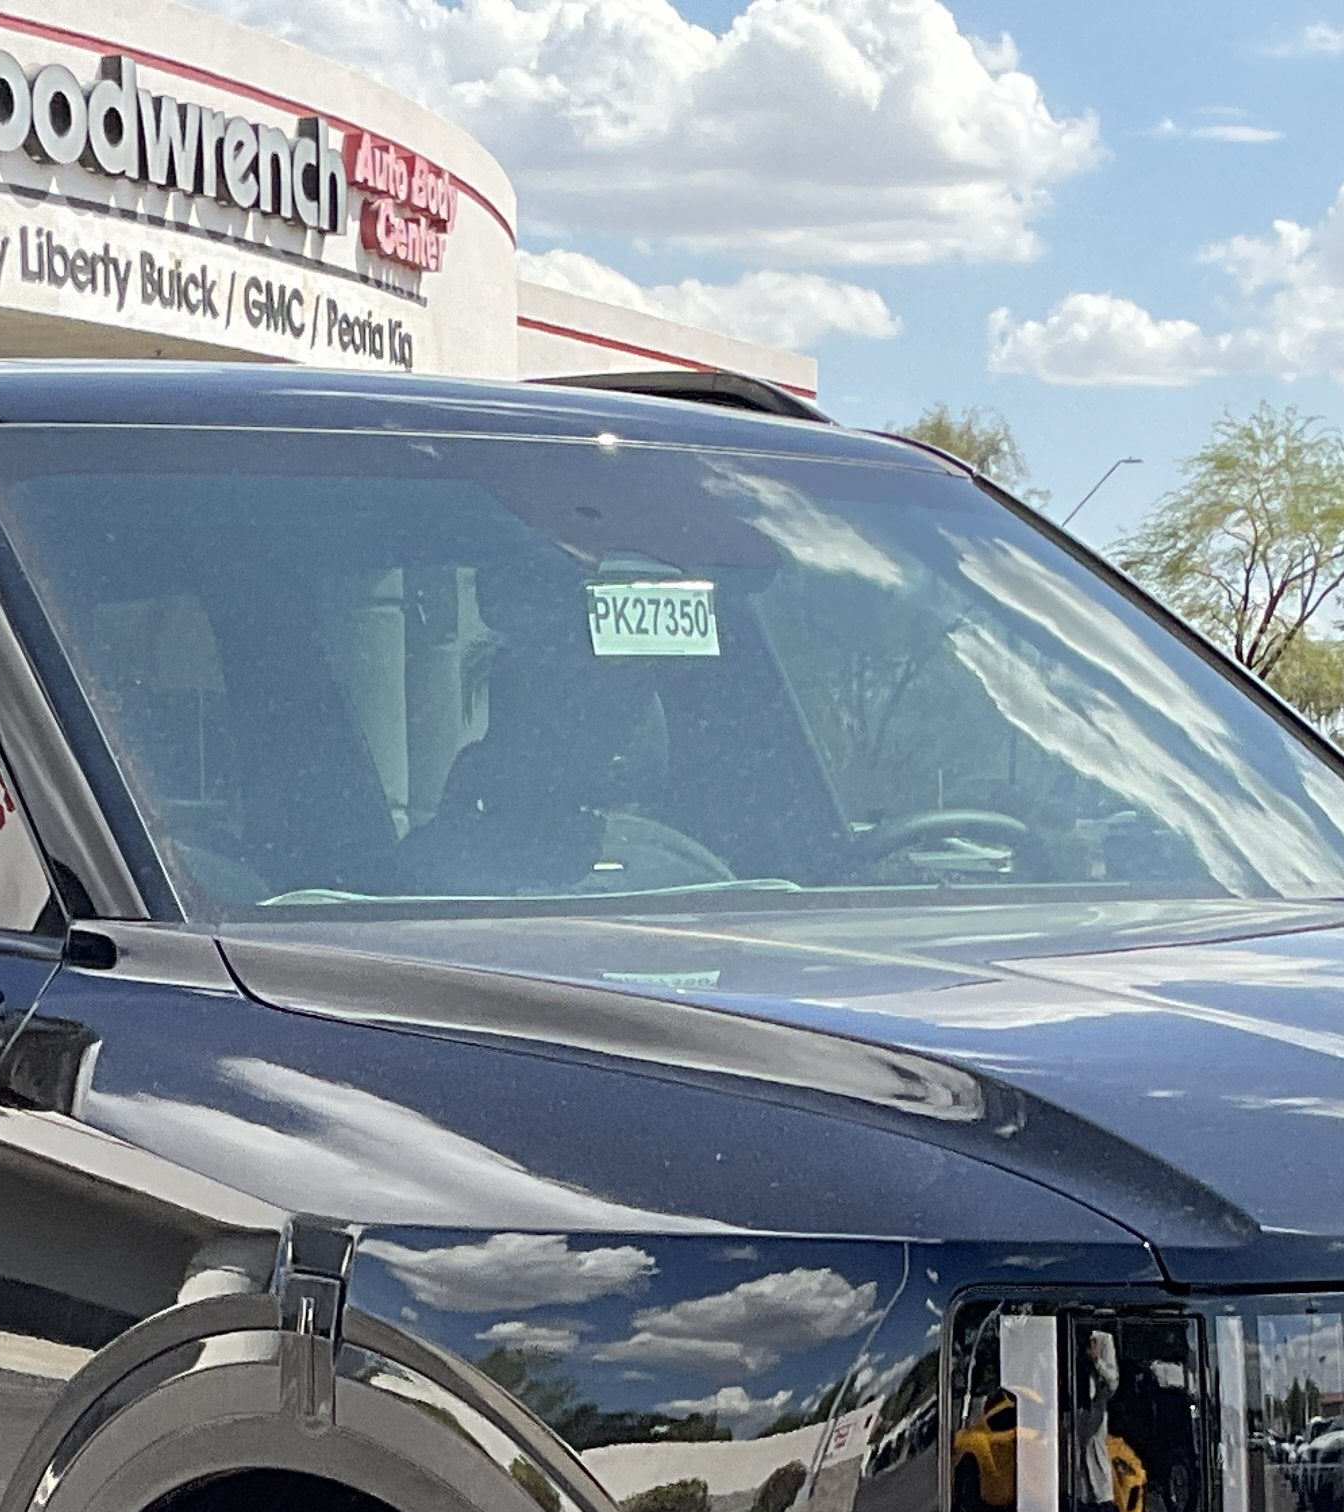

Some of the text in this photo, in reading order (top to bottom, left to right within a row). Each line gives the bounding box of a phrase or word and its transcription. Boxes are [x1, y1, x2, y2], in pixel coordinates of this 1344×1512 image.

[350, 132, 457, 235] Auto Body
[372, 198, 444, 273] Center
[20, 226, 132, 312] Liberty
[140, 250, 219, 319] Buick
[225, 270, 237, 330] /
[244, 276, 305, 339] GMC
[310, 294, 321, 350] /
[327, 297, 384, 360] Peoria
[593, 596, 709, 638] PK27350
